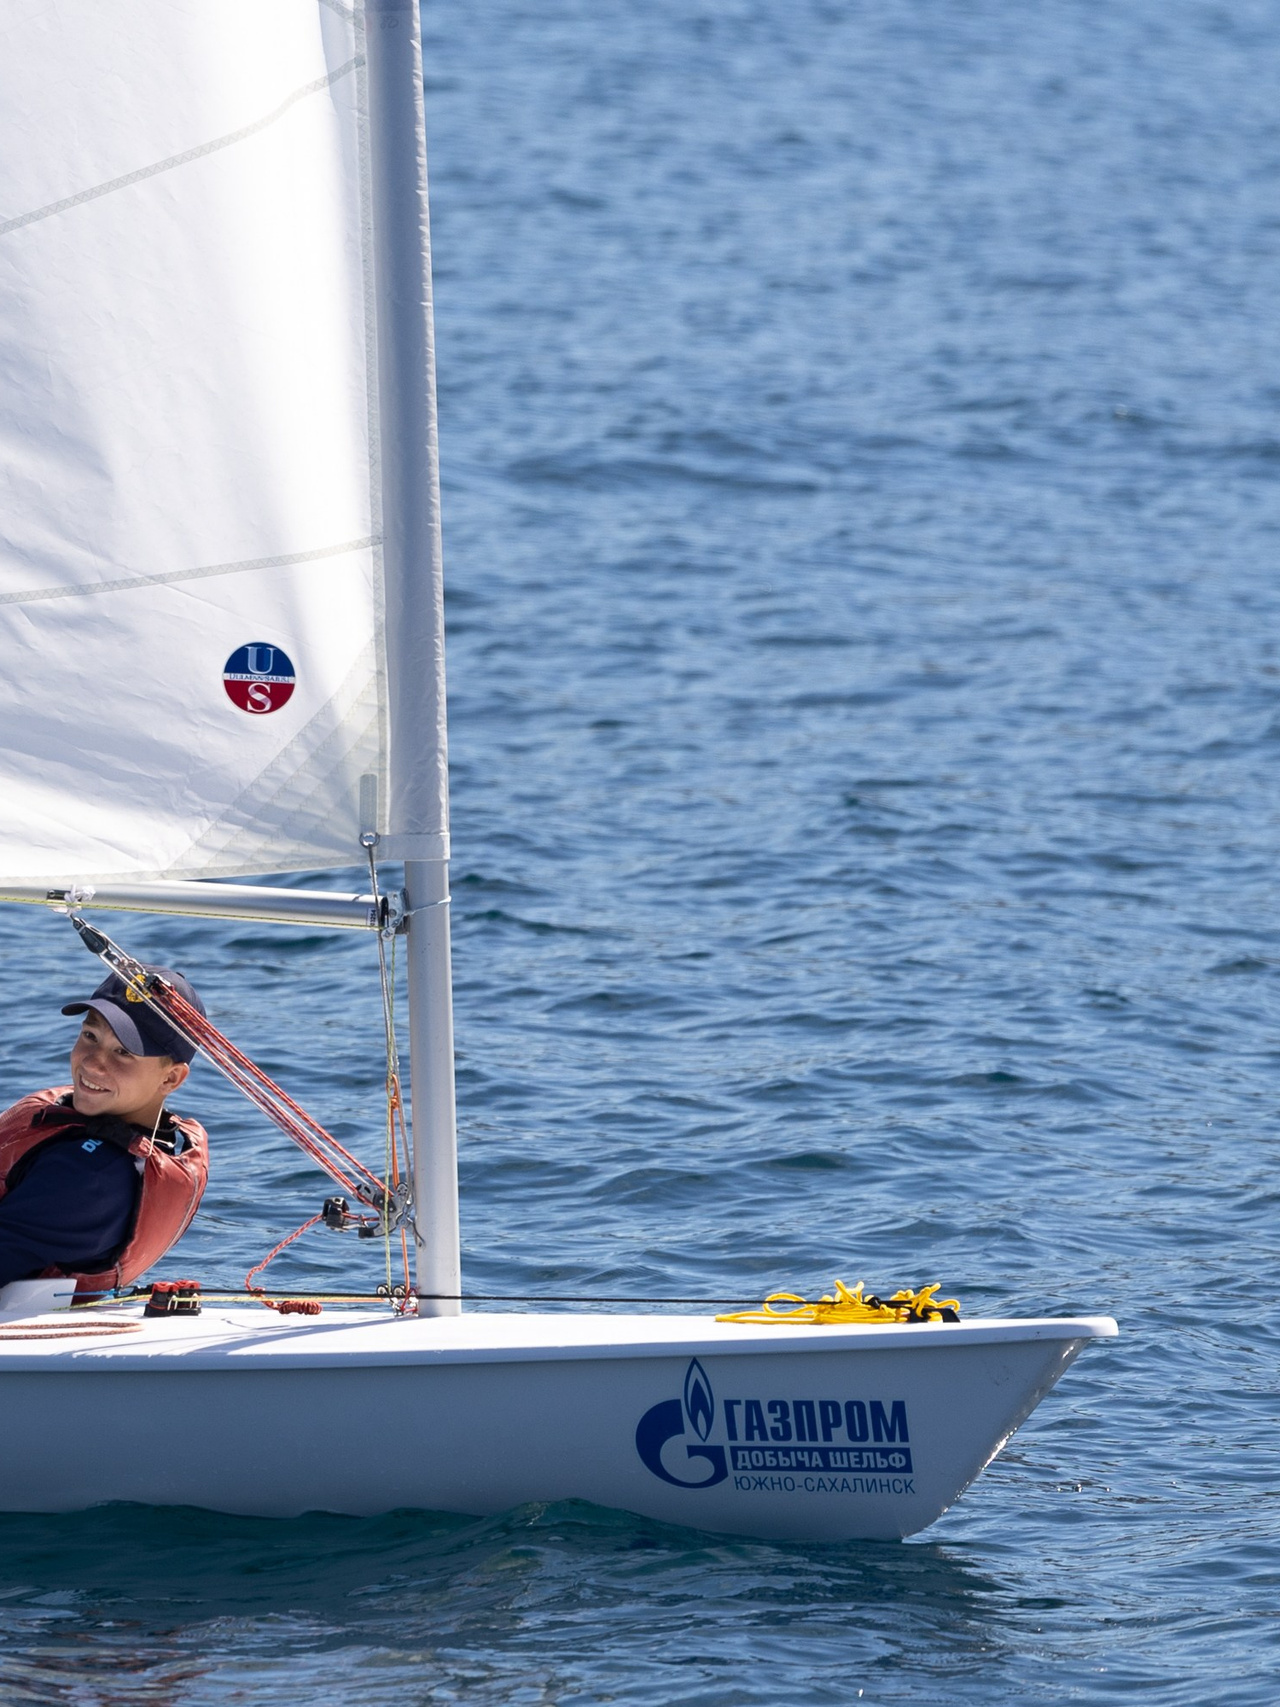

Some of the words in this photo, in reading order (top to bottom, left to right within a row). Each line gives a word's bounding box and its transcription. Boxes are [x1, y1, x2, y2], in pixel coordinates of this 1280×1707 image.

[245, 646, 277, 674] U
[247, 682, 272, 712] S
[723, 1399, 910, 1443] ГАЗПРОМ
[736, 1450, 823, 1469] ДОБЫЧА
[828, 1452, 907, 1469] ШЕЛЬФ
[734, 1476, 916, 1495] ЮЖНО-САХАЛИНСК
